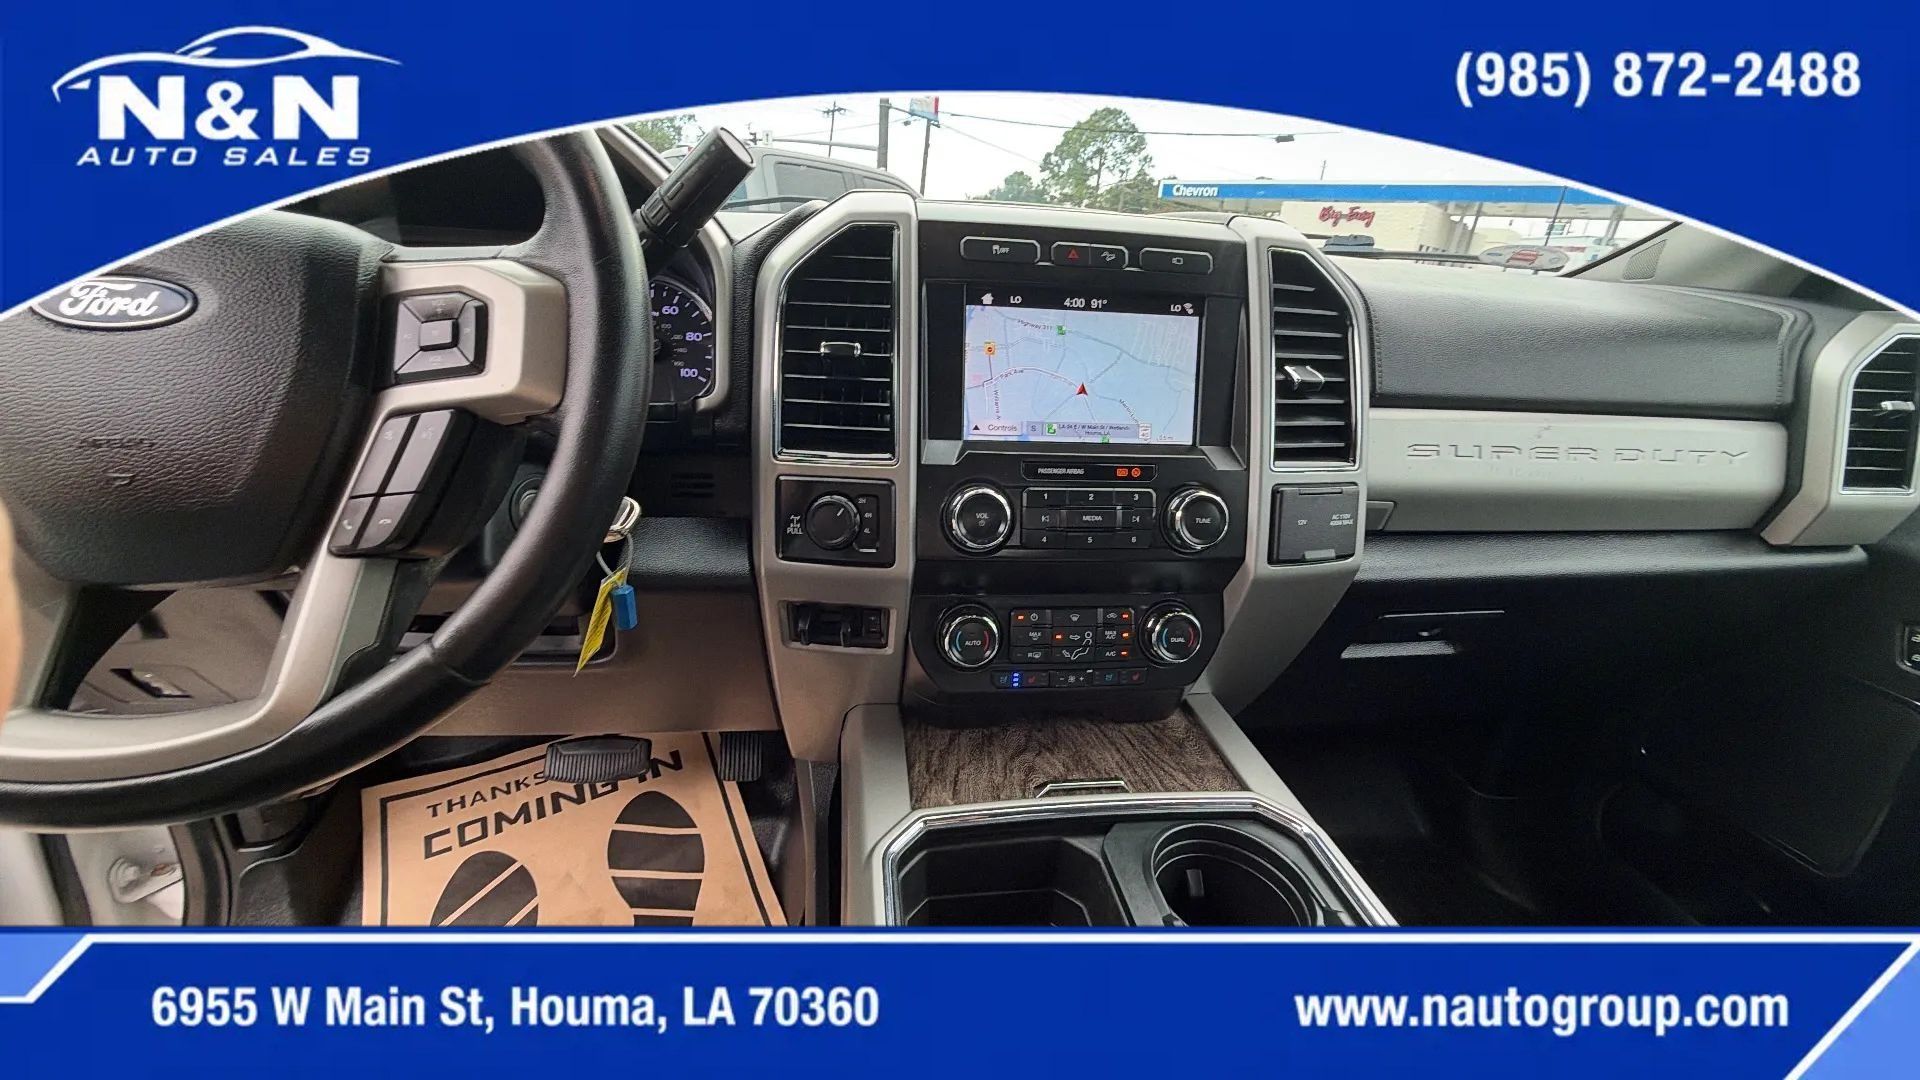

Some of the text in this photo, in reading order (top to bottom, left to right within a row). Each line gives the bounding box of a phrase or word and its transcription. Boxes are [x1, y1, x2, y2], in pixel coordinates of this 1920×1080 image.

[1172, 184, 1219, 198] Chevron
[59, 281, 161, 316] Ford
[1010, 295, 1022, 304] LO
[1063, 297, 1086, 309] 4:00
[661, 305, 679, 315] 60
[1170, 303, 1182, 313] LO
[685, 332, 703, 342] 80
[680, 368, 699, 378] 100
[987, 423, 1018, 432] Controls
[1406, 443, 1749, 465] SUPER DUTY
[1037, 467, 1067, 475] PASSENGER
[787, 527, 803, 535] PULL
[965, 639, 982, 647] AUTO
